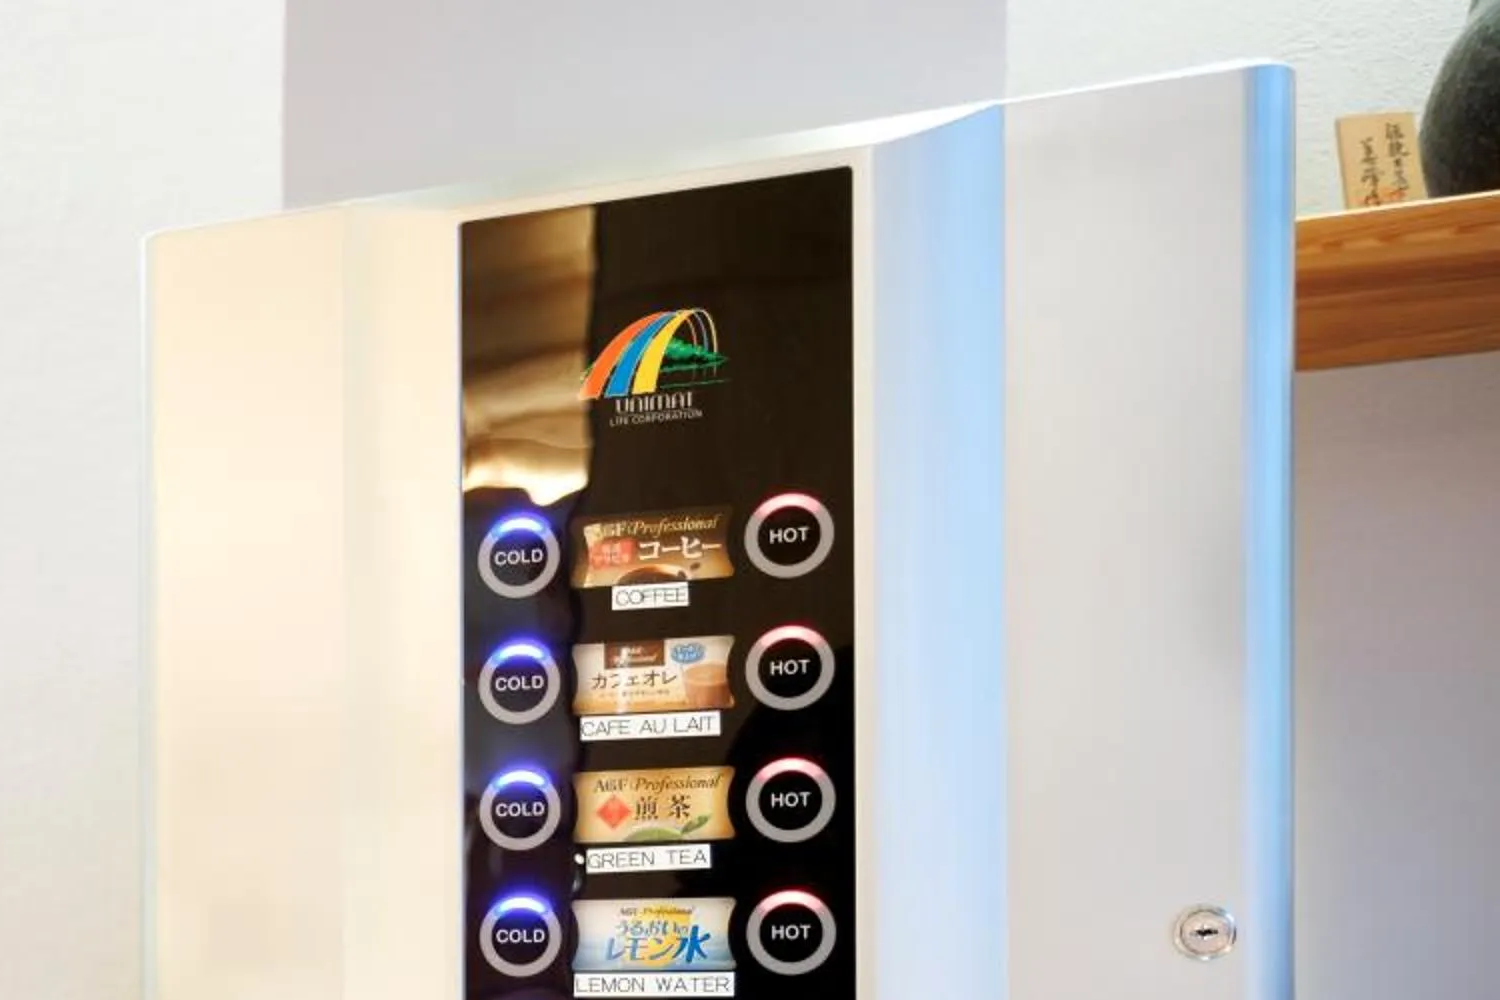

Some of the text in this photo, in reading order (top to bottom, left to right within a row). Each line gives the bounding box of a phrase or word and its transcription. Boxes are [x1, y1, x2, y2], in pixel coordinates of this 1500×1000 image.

[768, 526, 810, 545] HOT
[494, 548, 544, 566] COLD
[639, 536, 722, 560] コーヒー
[616, 586, 687, 606] COFFEE
[769, 659, 811, 677] HOT
[495, 676, 544, 692] COLD
[581, 716, 717, 737] CAFE AU LAIT
[635, 772, 724, 794] Professional
[770, 791, 812, 808] HOT
[495, 802, 545, 818] COLD
[587, 849, 707, 869] GREEN TEA
[496, 928, 546, 944] COLD
[771, 924, 812, 941] HOT
[605, 924, 711, 964] レモン水
[575, 977, 730, 993] LEMON WATER
